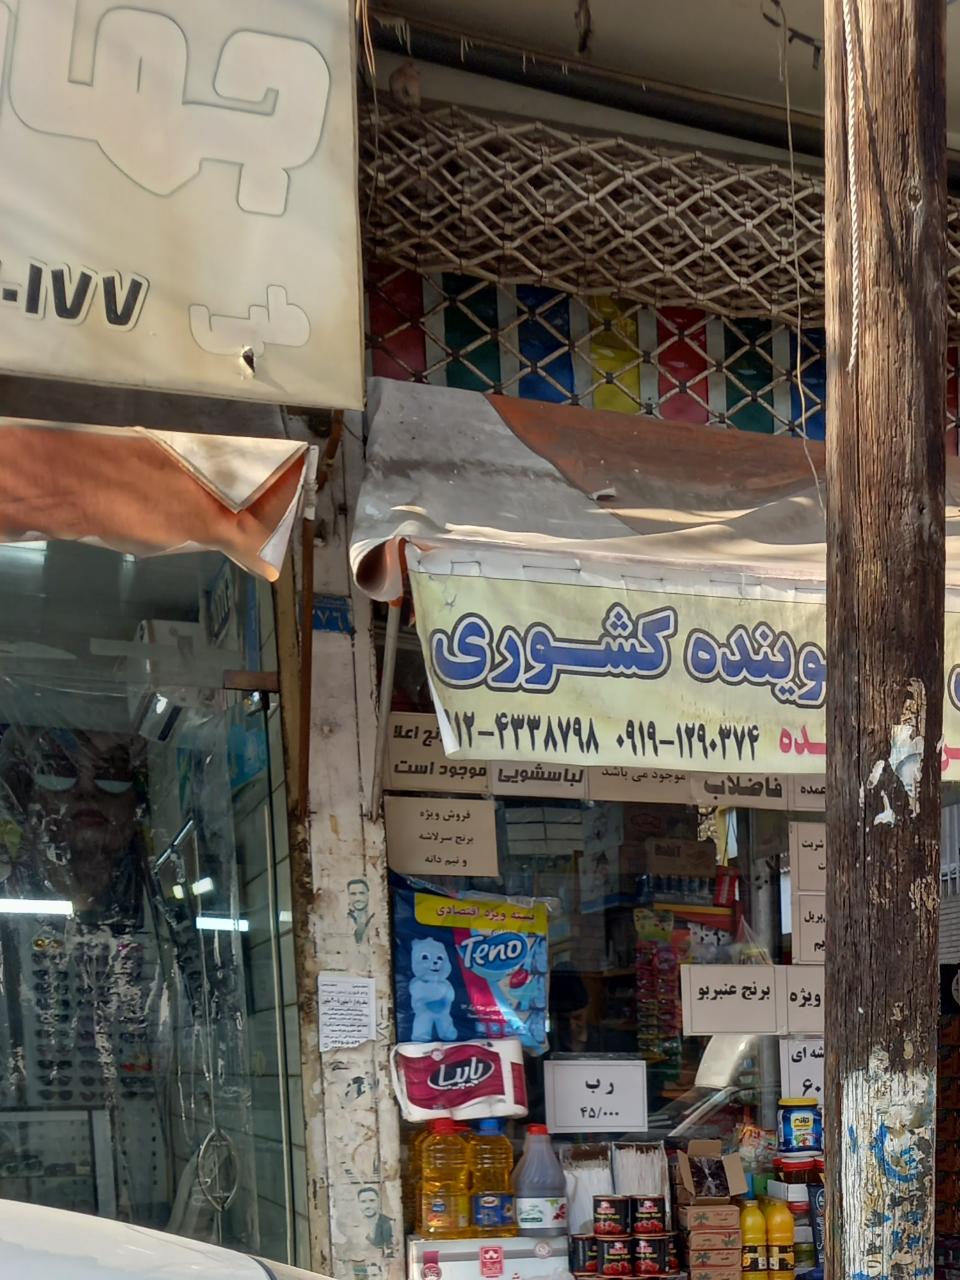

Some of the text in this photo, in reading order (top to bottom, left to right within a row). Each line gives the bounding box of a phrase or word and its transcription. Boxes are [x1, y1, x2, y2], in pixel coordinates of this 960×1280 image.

[428, 602, 678, 694] کشوری
[684, 620, 827, 708] وینده
[392, 724, 421, 740] اعلا
[616, 719, 760, 761] ۰۹۱۹-۱۲۹۰۳۷۴
[393, 761, 488, 780] موجود است
[498, 763, 584, 787] لباسشویی
[601, 767, 628, 781] باشد
[654, 772, 686, 783] موجود
[419, 809, 471, 822] فروش ویژه
[456, 831, 474, 843] برنج
[460, 936, 522, 968] Teno
[697, 981, 771, 1001] برنج عنبربو
[789, 987, 822, 1008] ویژه
